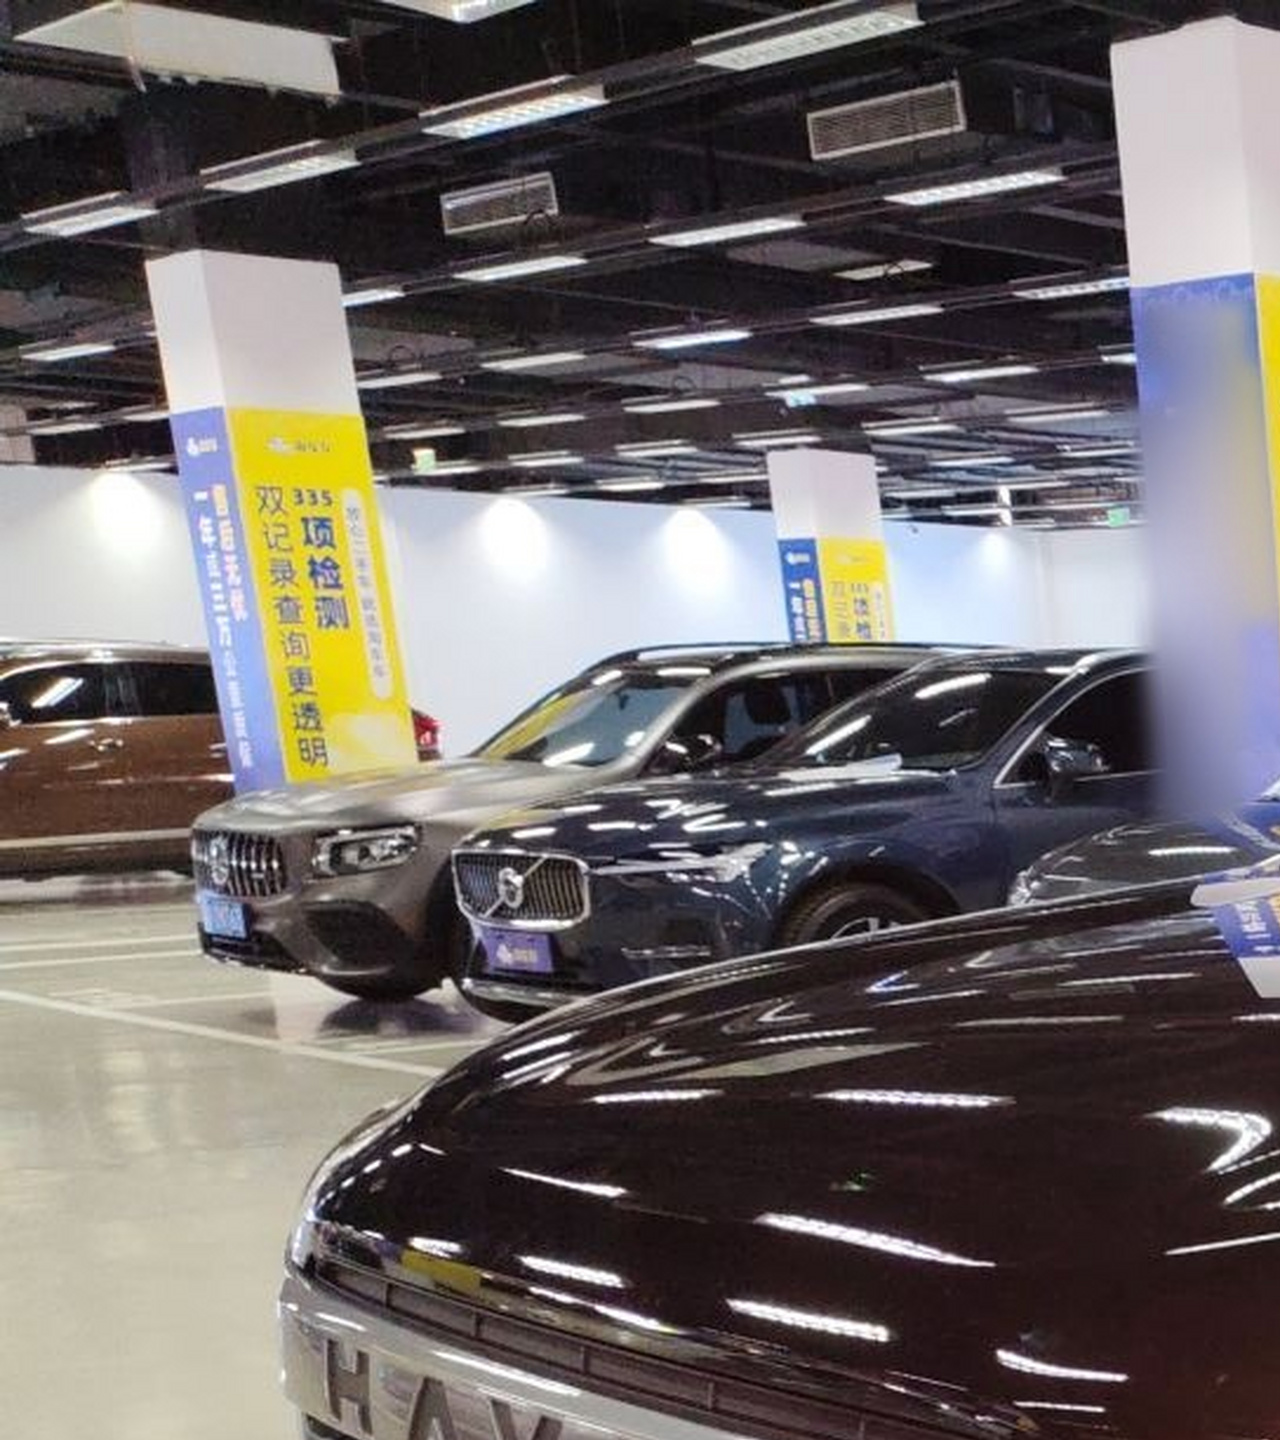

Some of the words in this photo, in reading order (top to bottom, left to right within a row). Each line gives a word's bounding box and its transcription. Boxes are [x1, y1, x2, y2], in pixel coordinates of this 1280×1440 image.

[255, 485, 330, 768] 双记录查询更透明
